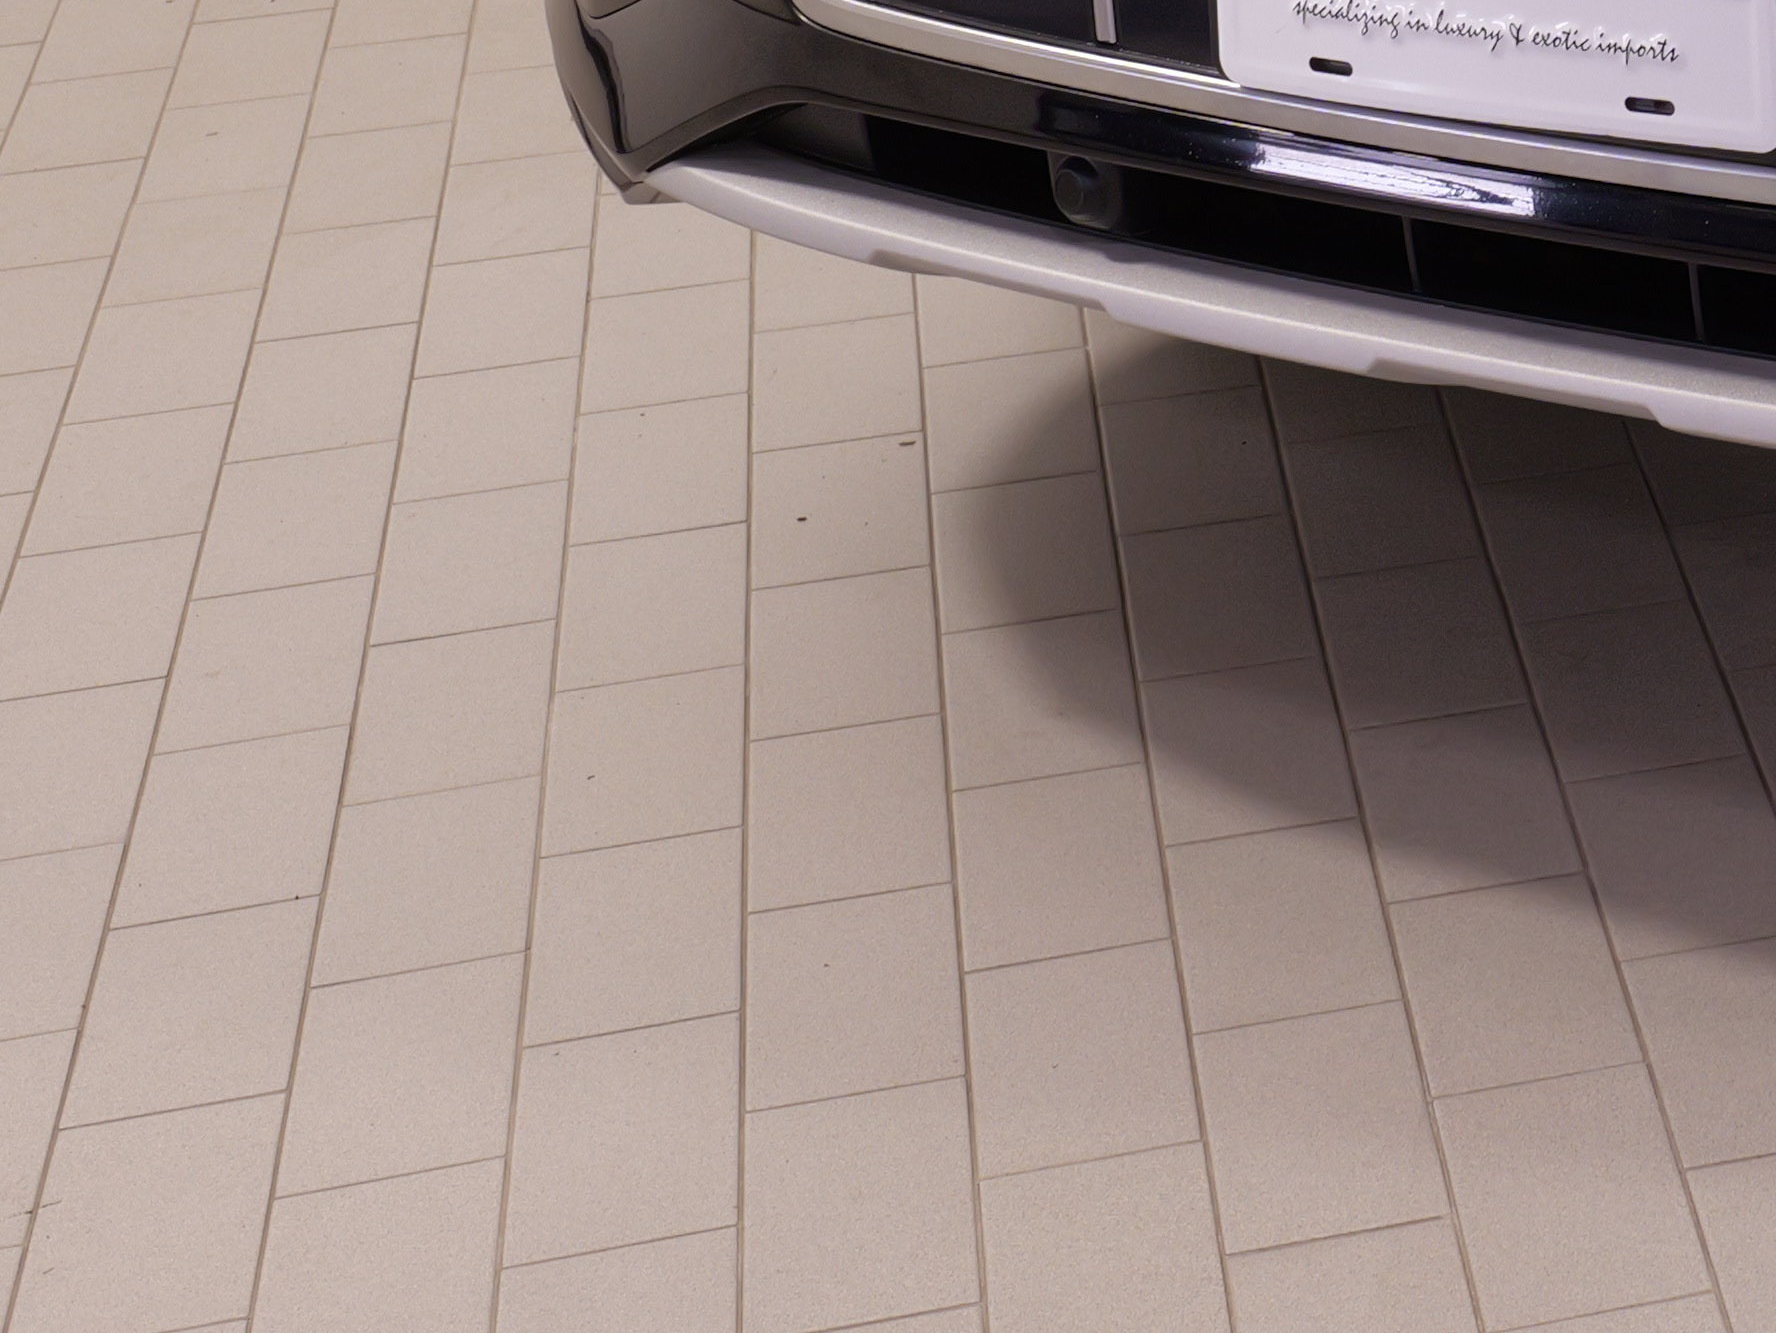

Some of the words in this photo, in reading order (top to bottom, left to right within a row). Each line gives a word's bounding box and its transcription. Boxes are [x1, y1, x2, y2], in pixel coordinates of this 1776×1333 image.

[1404, 9, 1430, 33] in
[1433, 8, 1504, 53] luxury
[1531, 29, 1591, 53] exotic
[1595, 32, 1680, 66] imports
